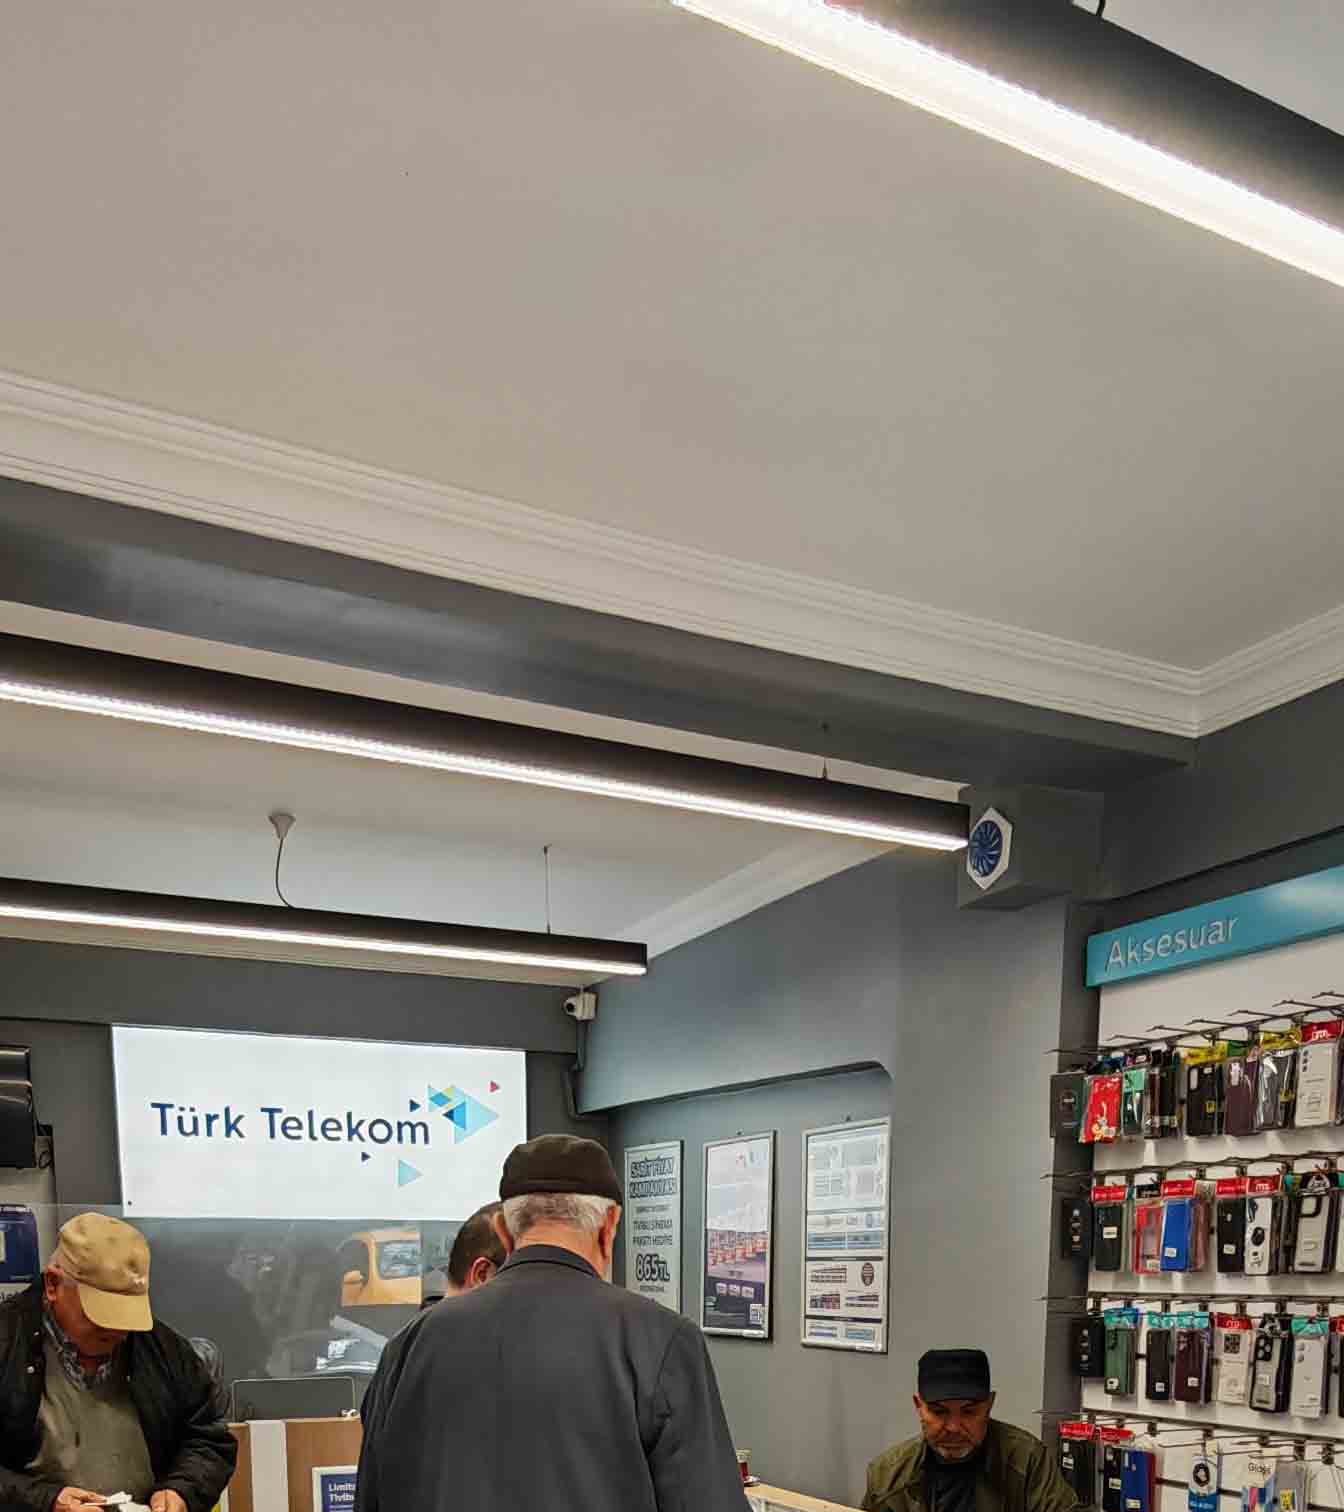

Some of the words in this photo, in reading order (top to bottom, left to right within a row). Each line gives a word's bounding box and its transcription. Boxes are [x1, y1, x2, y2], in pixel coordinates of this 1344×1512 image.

[1105, 913, 1238, 974] Aksesuar
[150, 1101, 246, 1141] Türk
[259, 1106, 431, 1147] Telekom
